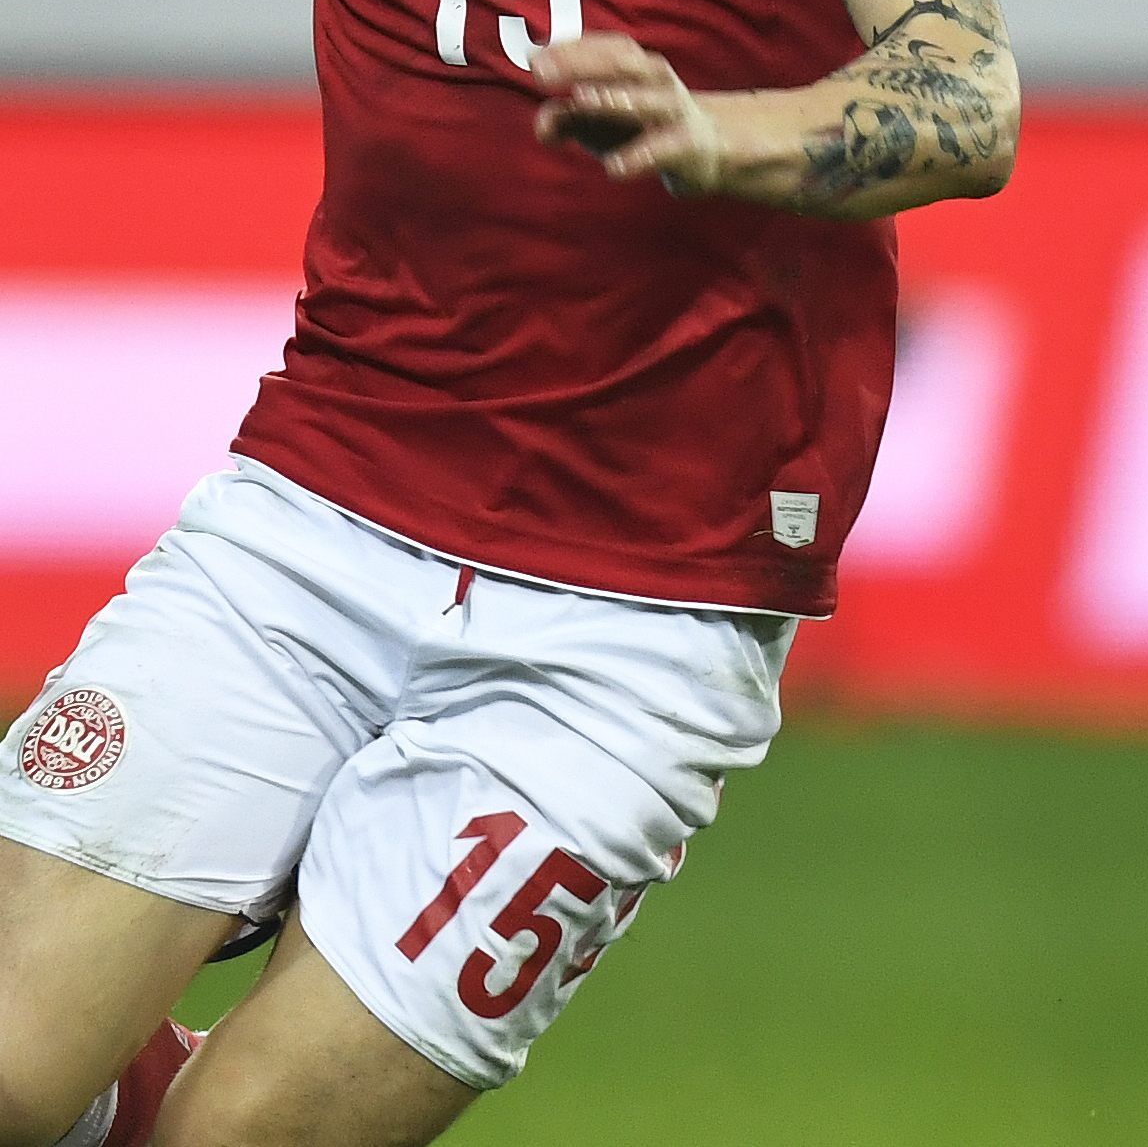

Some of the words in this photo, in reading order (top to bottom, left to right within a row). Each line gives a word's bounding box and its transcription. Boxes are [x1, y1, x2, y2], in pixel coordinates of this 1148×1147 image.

[22, 703, 58, 763] DANSK
[72, 740, 123, 788] UNION
[41, 714, 106, 764] DBU
[26, 763, 65, 789] 1889
[395, 810, 609, 1019] 15
